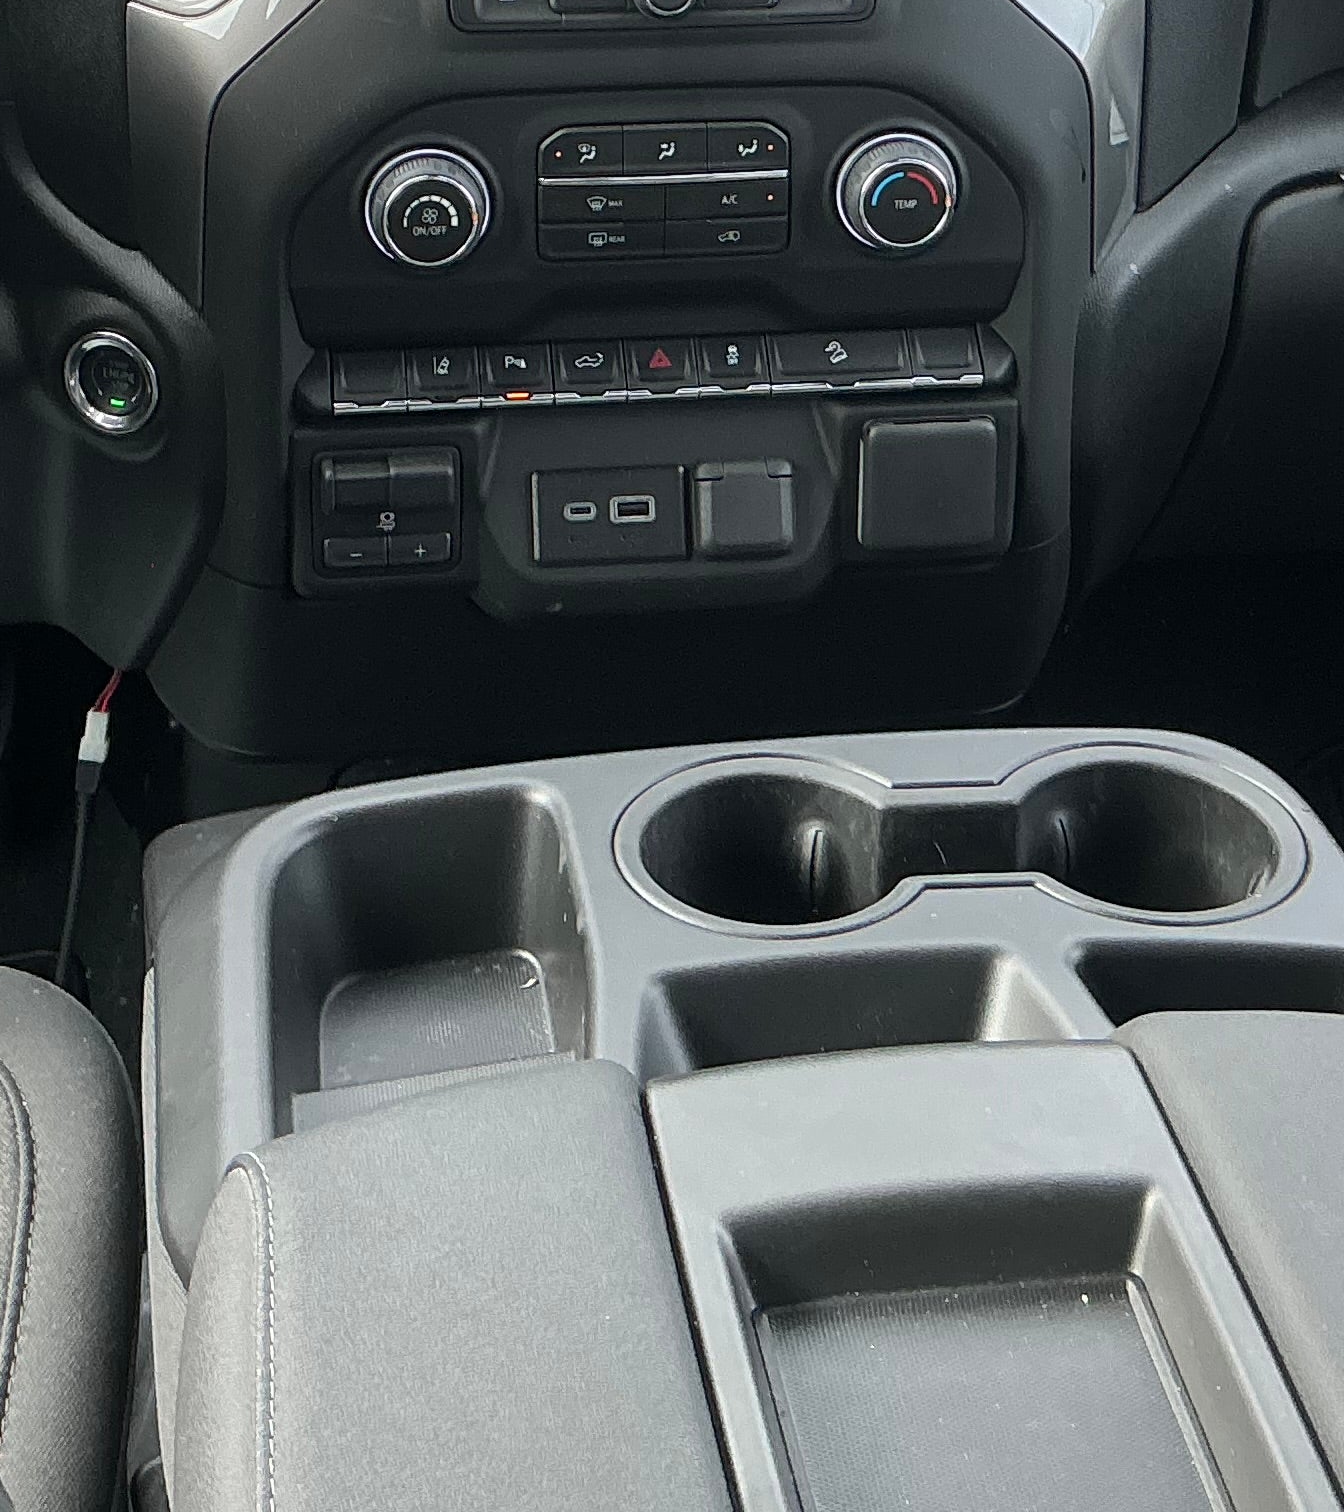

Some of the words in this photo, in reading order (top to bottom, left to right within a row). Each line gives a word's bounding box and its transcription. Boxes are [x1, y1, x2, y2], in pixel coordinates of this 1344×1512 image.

[720, 194, 738, 205] A/C
[894, 199, 918, 210] TEMP
[412, 226, 447, 237] ON/OFF
